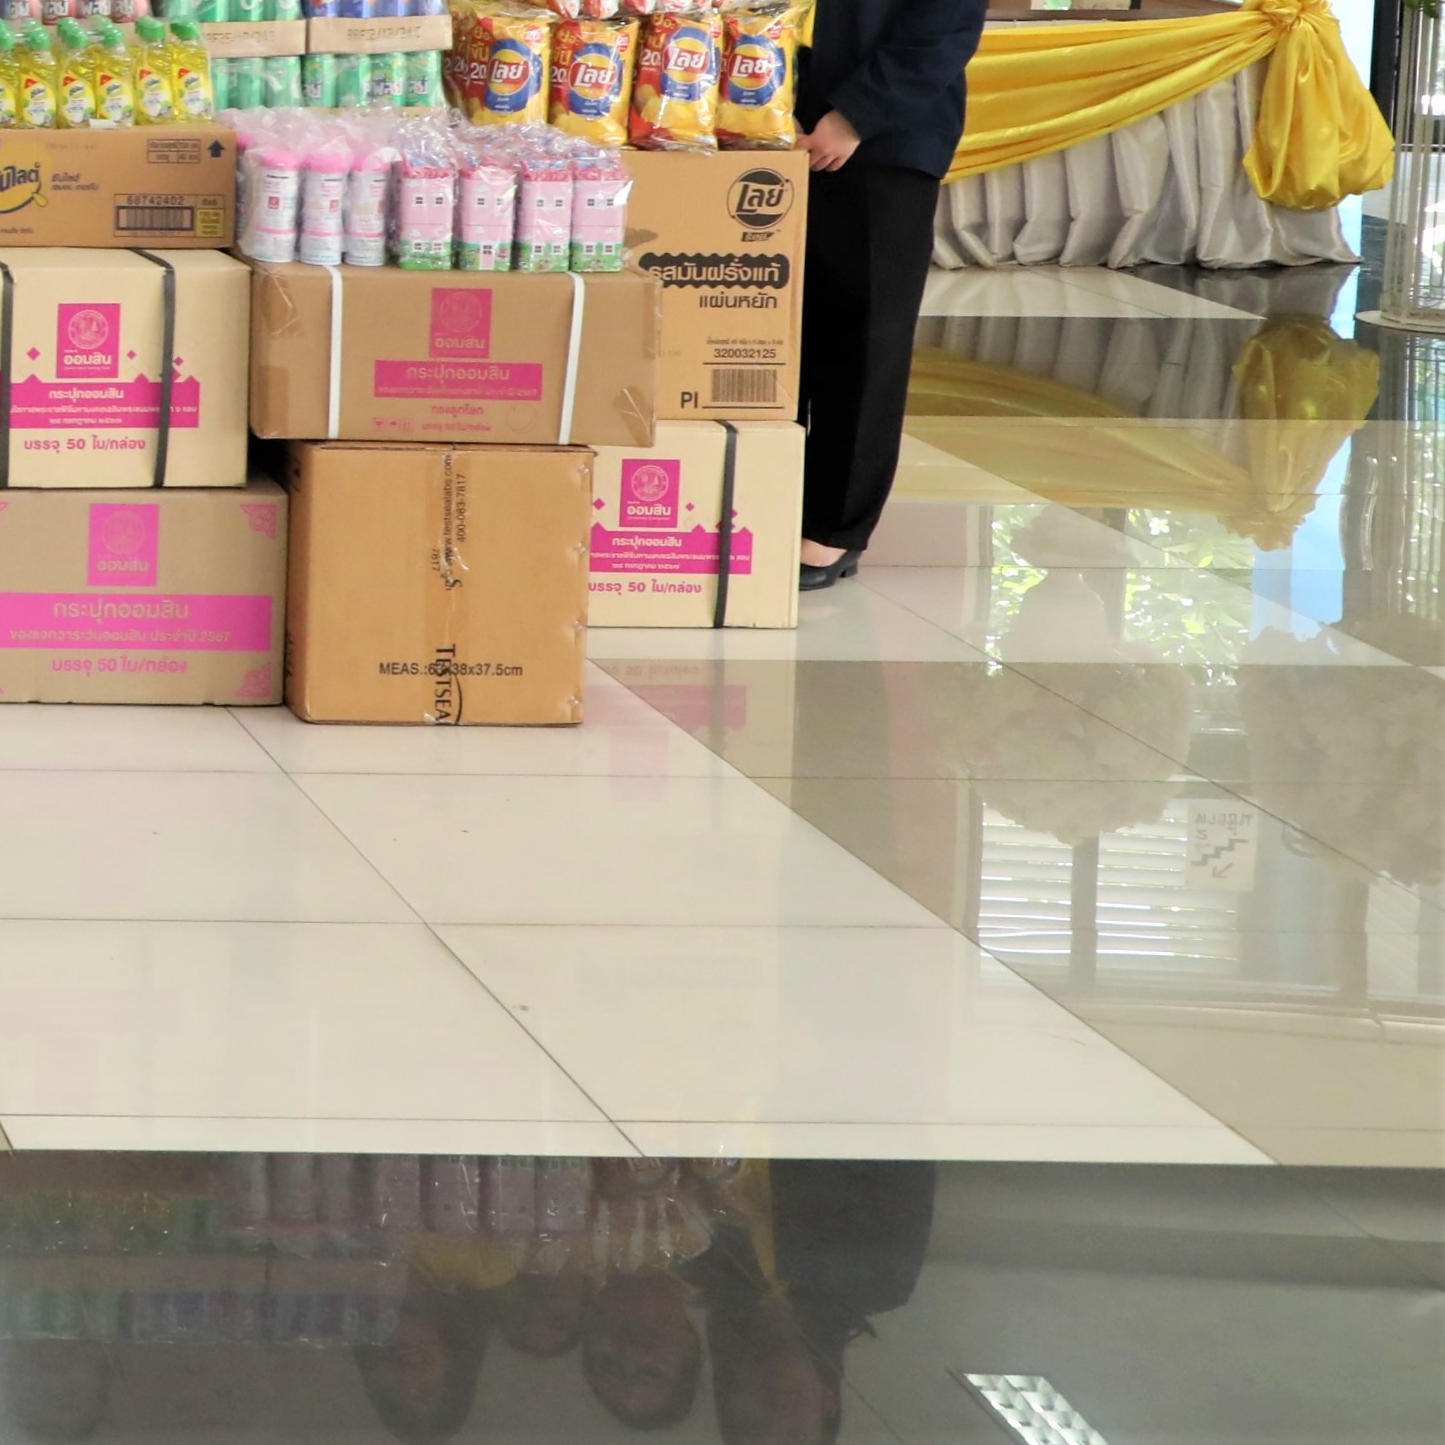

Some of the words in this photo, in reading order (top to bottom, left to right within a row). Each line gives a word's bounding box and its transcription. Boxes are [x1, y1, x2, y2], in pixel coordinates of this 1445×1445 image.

[735, 181, 785, 214] เลย์
[699, 292, 778, 309] แผ่นหยัก
[63, 353, 111, 366] ออมสิน
[713, 348, 777, 359] 320032125
[48, 387, 124, 404] กระปุกออมสิน
[680, 391, 698, 409] PI
[24, 438, 60, 454] บรรจุ
[66, 438, 86, 450] 50
[91, 434, 146, 452] ใบ/กล่อง
[626, 503, 672, 516] ออมสิน
[612, 535, 683, 550] กระปุกออมสิน
[588, 581, 623, 596] บรรจุ
[628, 581, 647, 593] 50
[651, 578, 702, 594] ใบ/กล่อง
[52, 597, 190, 625] กระปุกออมสิน
[52, 658, 93, 677] บรรจุ
[97, 658, 118, 673] 50
[121, 655, 189, 675] ใบ/กล่อง
